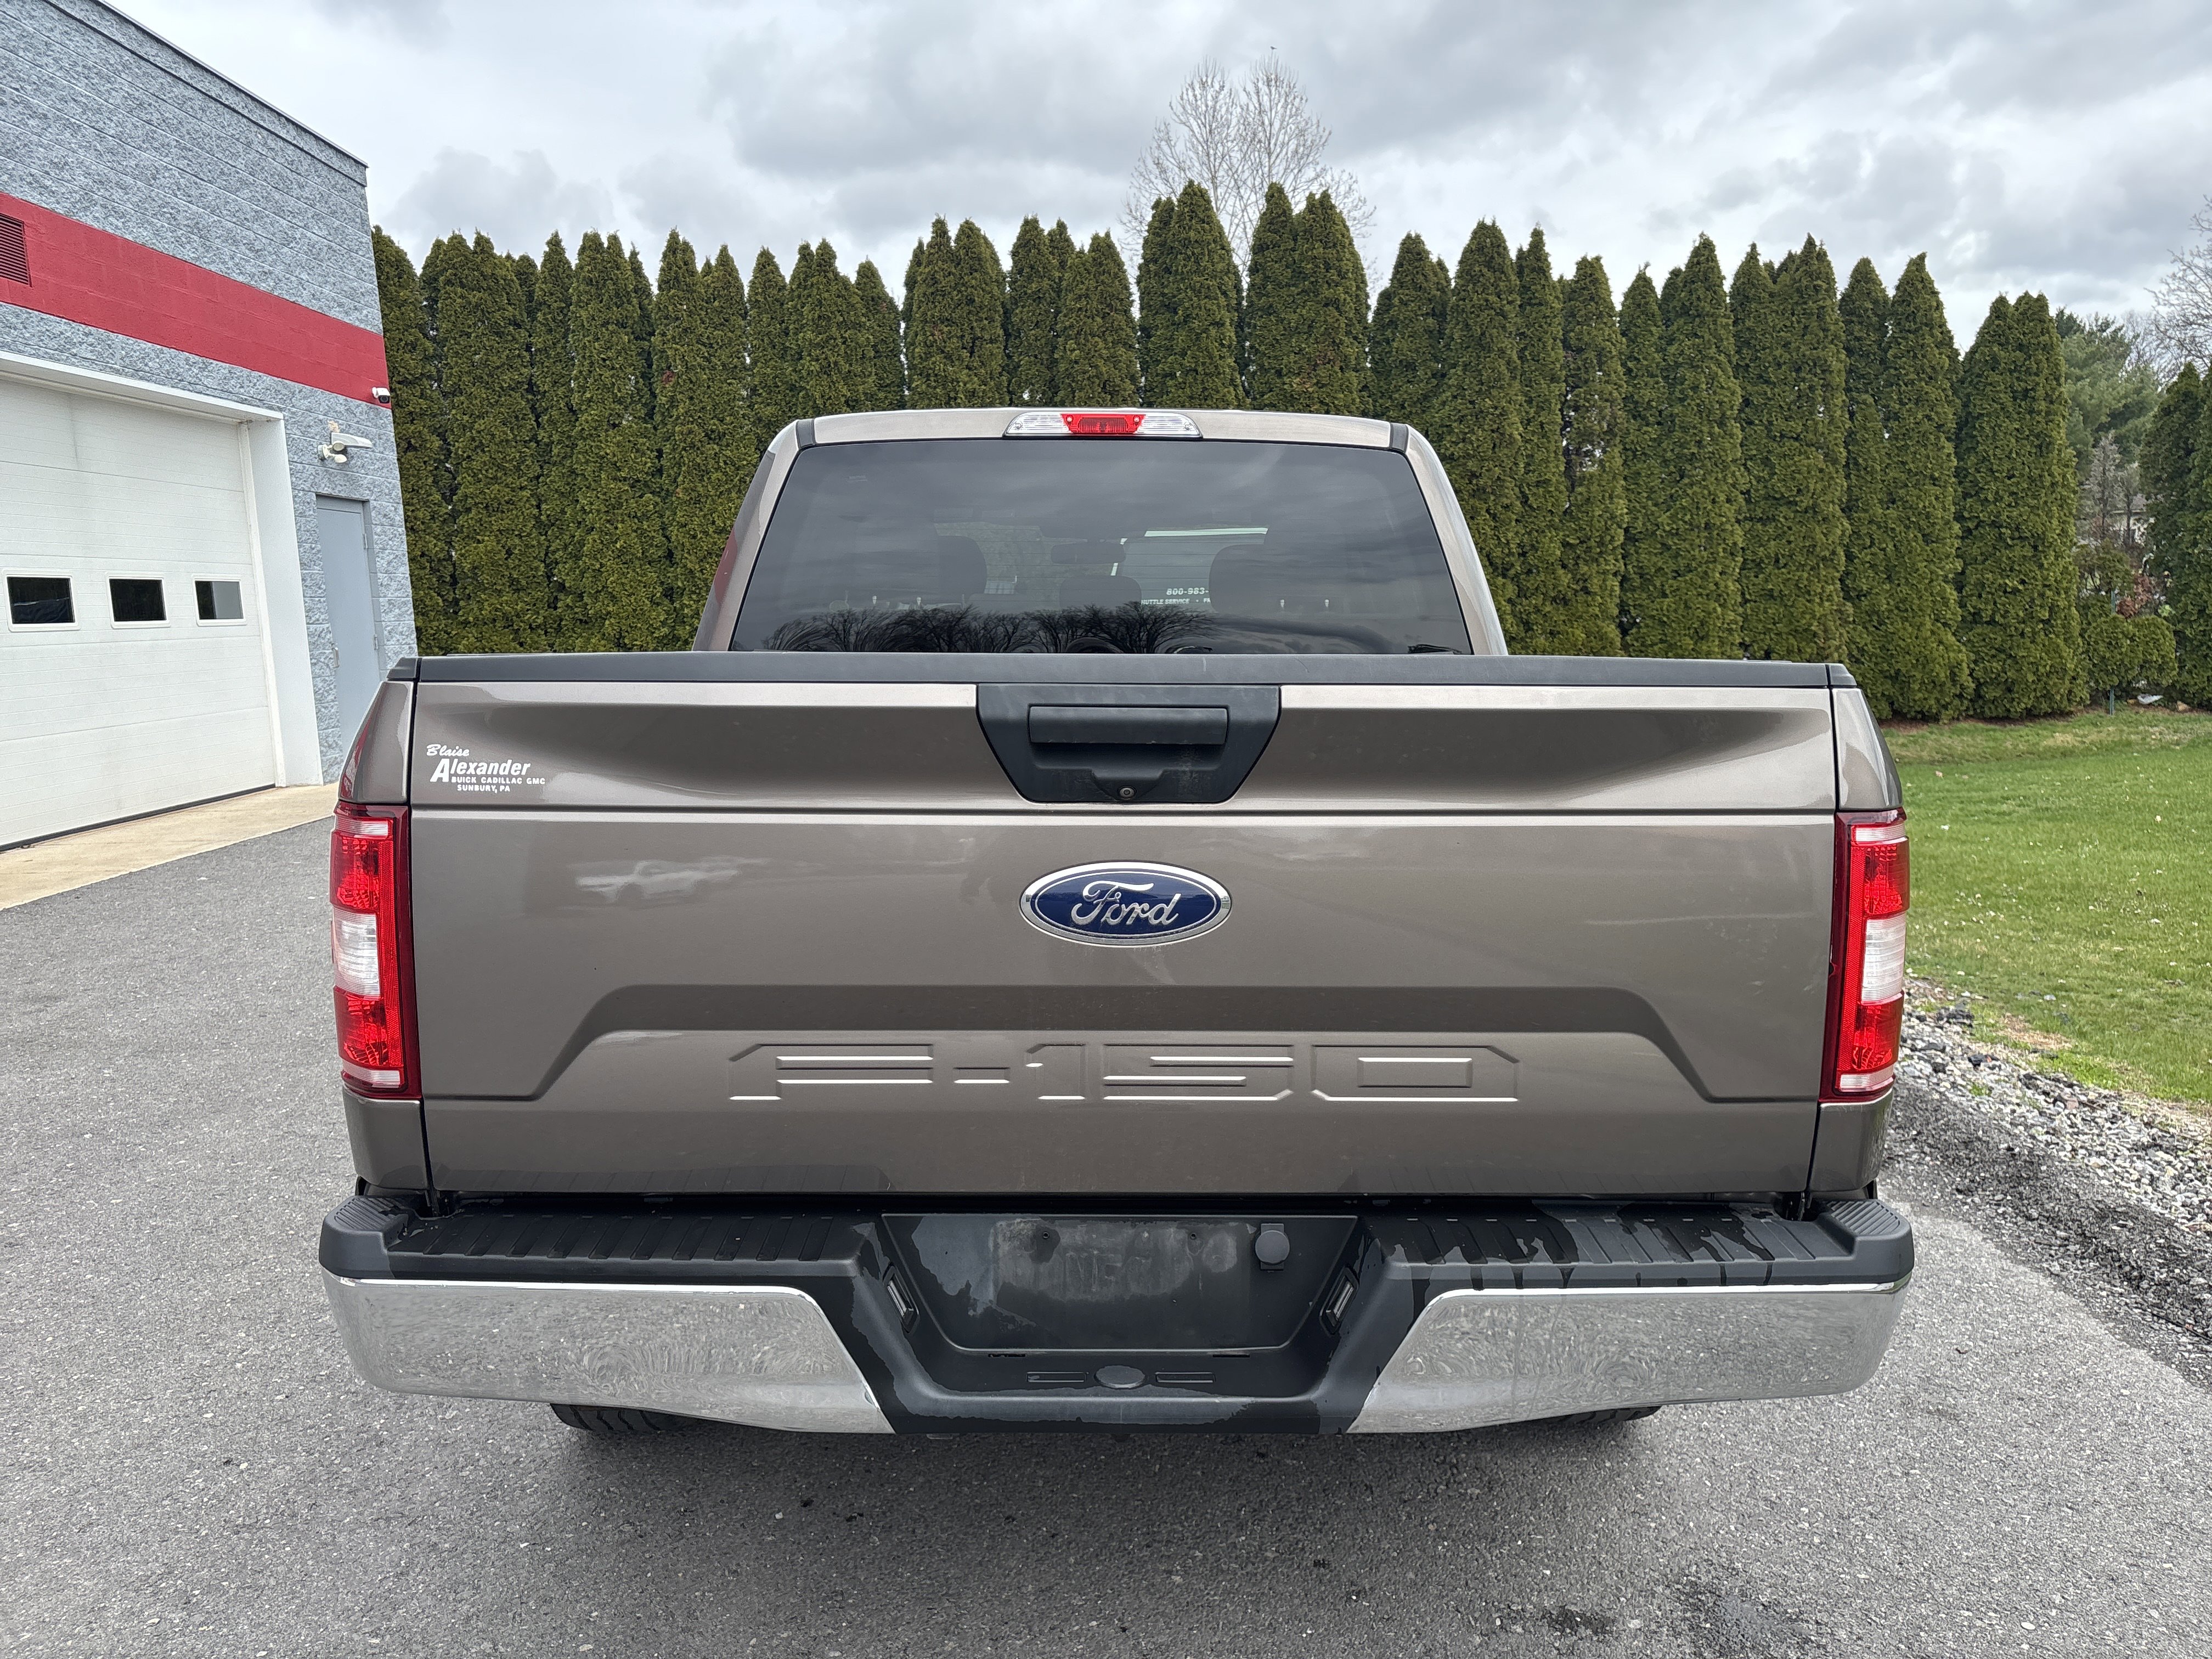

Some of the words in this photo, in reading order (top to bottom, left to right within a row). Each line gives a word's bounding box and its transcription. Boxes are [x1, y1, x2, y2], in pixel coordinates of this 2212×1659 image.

[426, 744, 470, 757] Blaise
[430, 758, 531, 782] Alexander
[457, 784, 498, 793] SUNBURY,
[1071, 881, 1182, 925] Ford
[729, 1043, 1520, 1102] F-150
